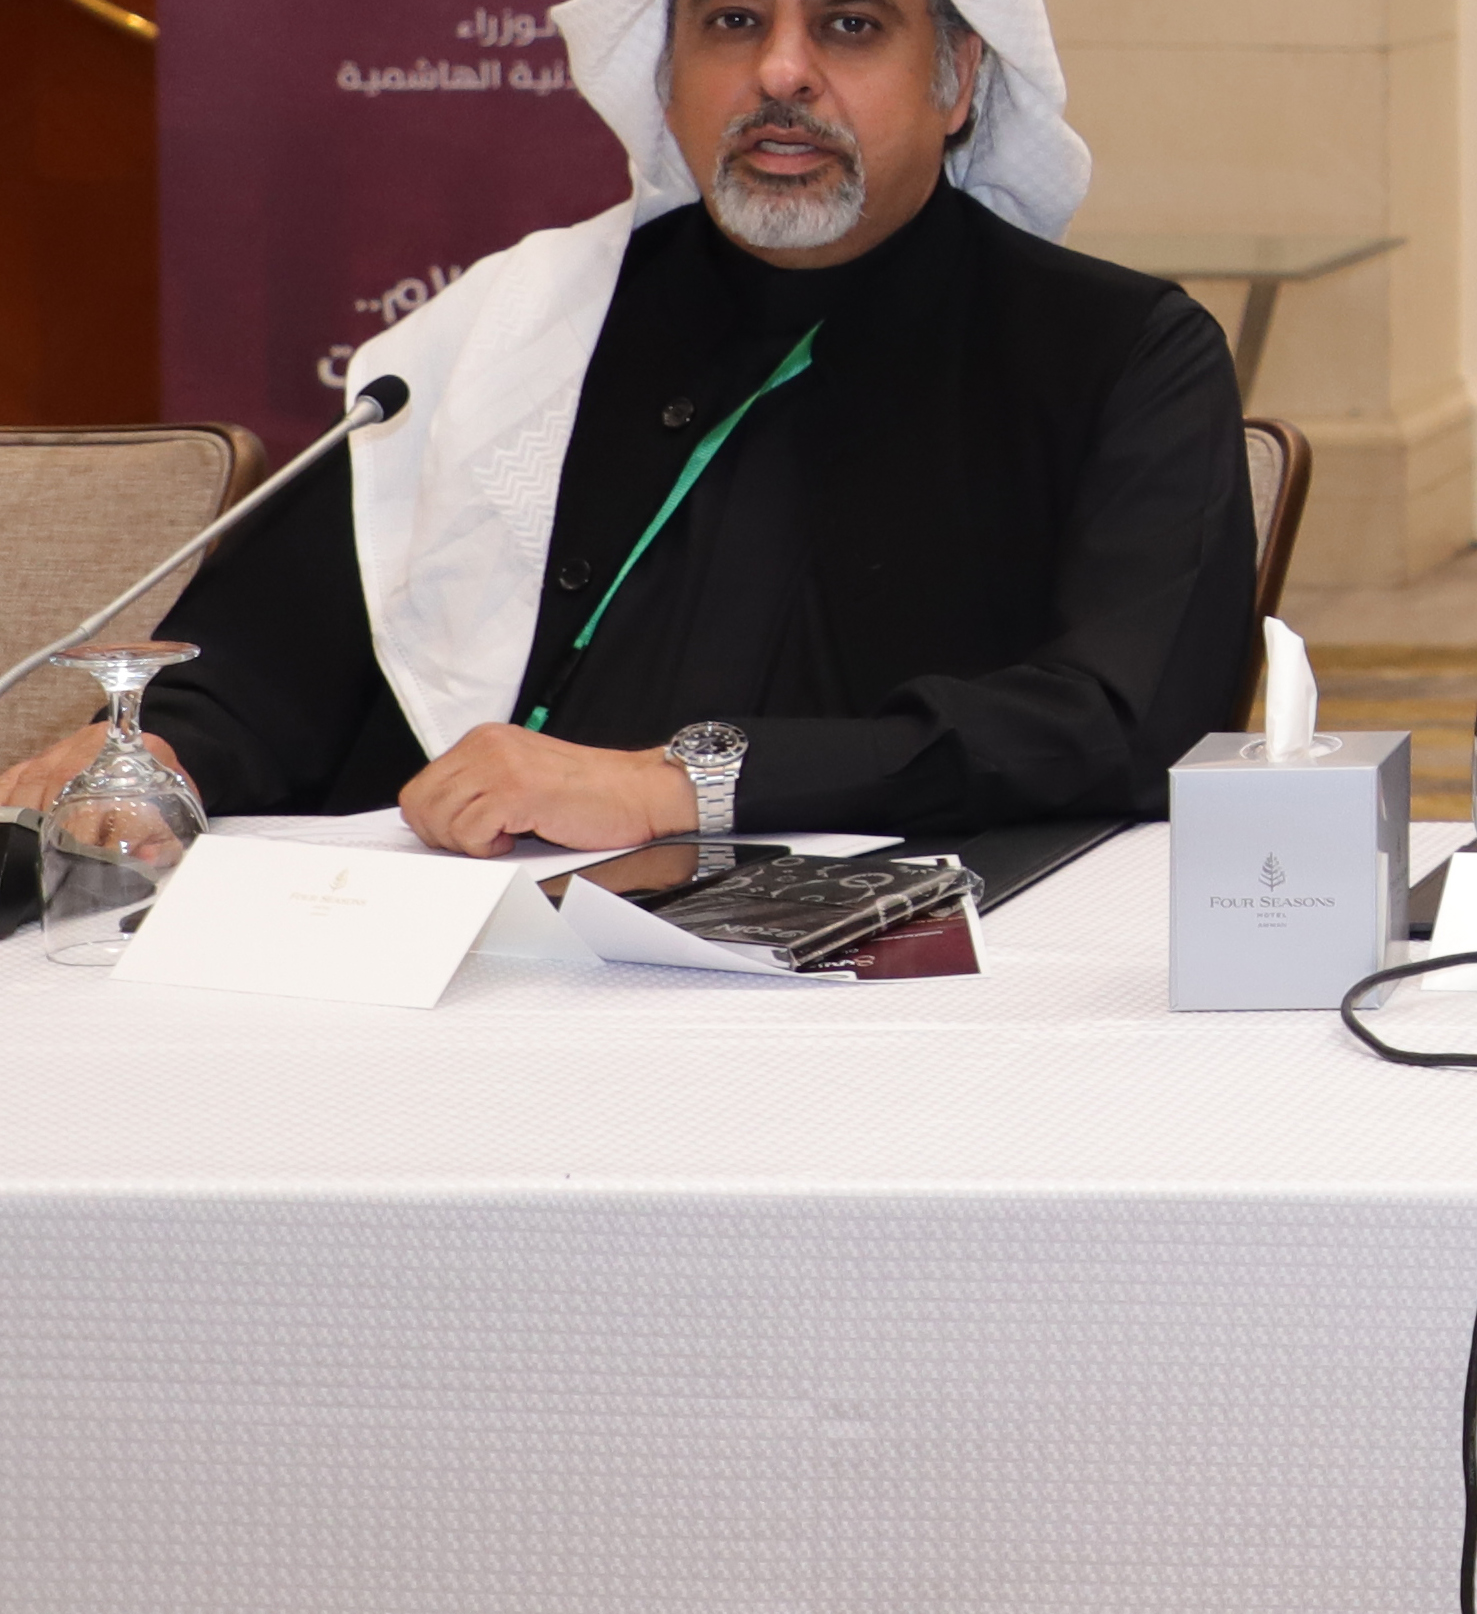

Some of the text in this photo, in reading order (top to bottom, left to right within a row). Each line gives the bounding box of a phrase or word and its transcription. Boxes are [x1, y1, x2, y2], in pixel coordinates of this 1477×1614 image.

[455, 6, 558, 47] لوزراء
[336, 58, 501, 97] الهاشمية
[1209, 896, 1336, 909] FOUR SEASONS
